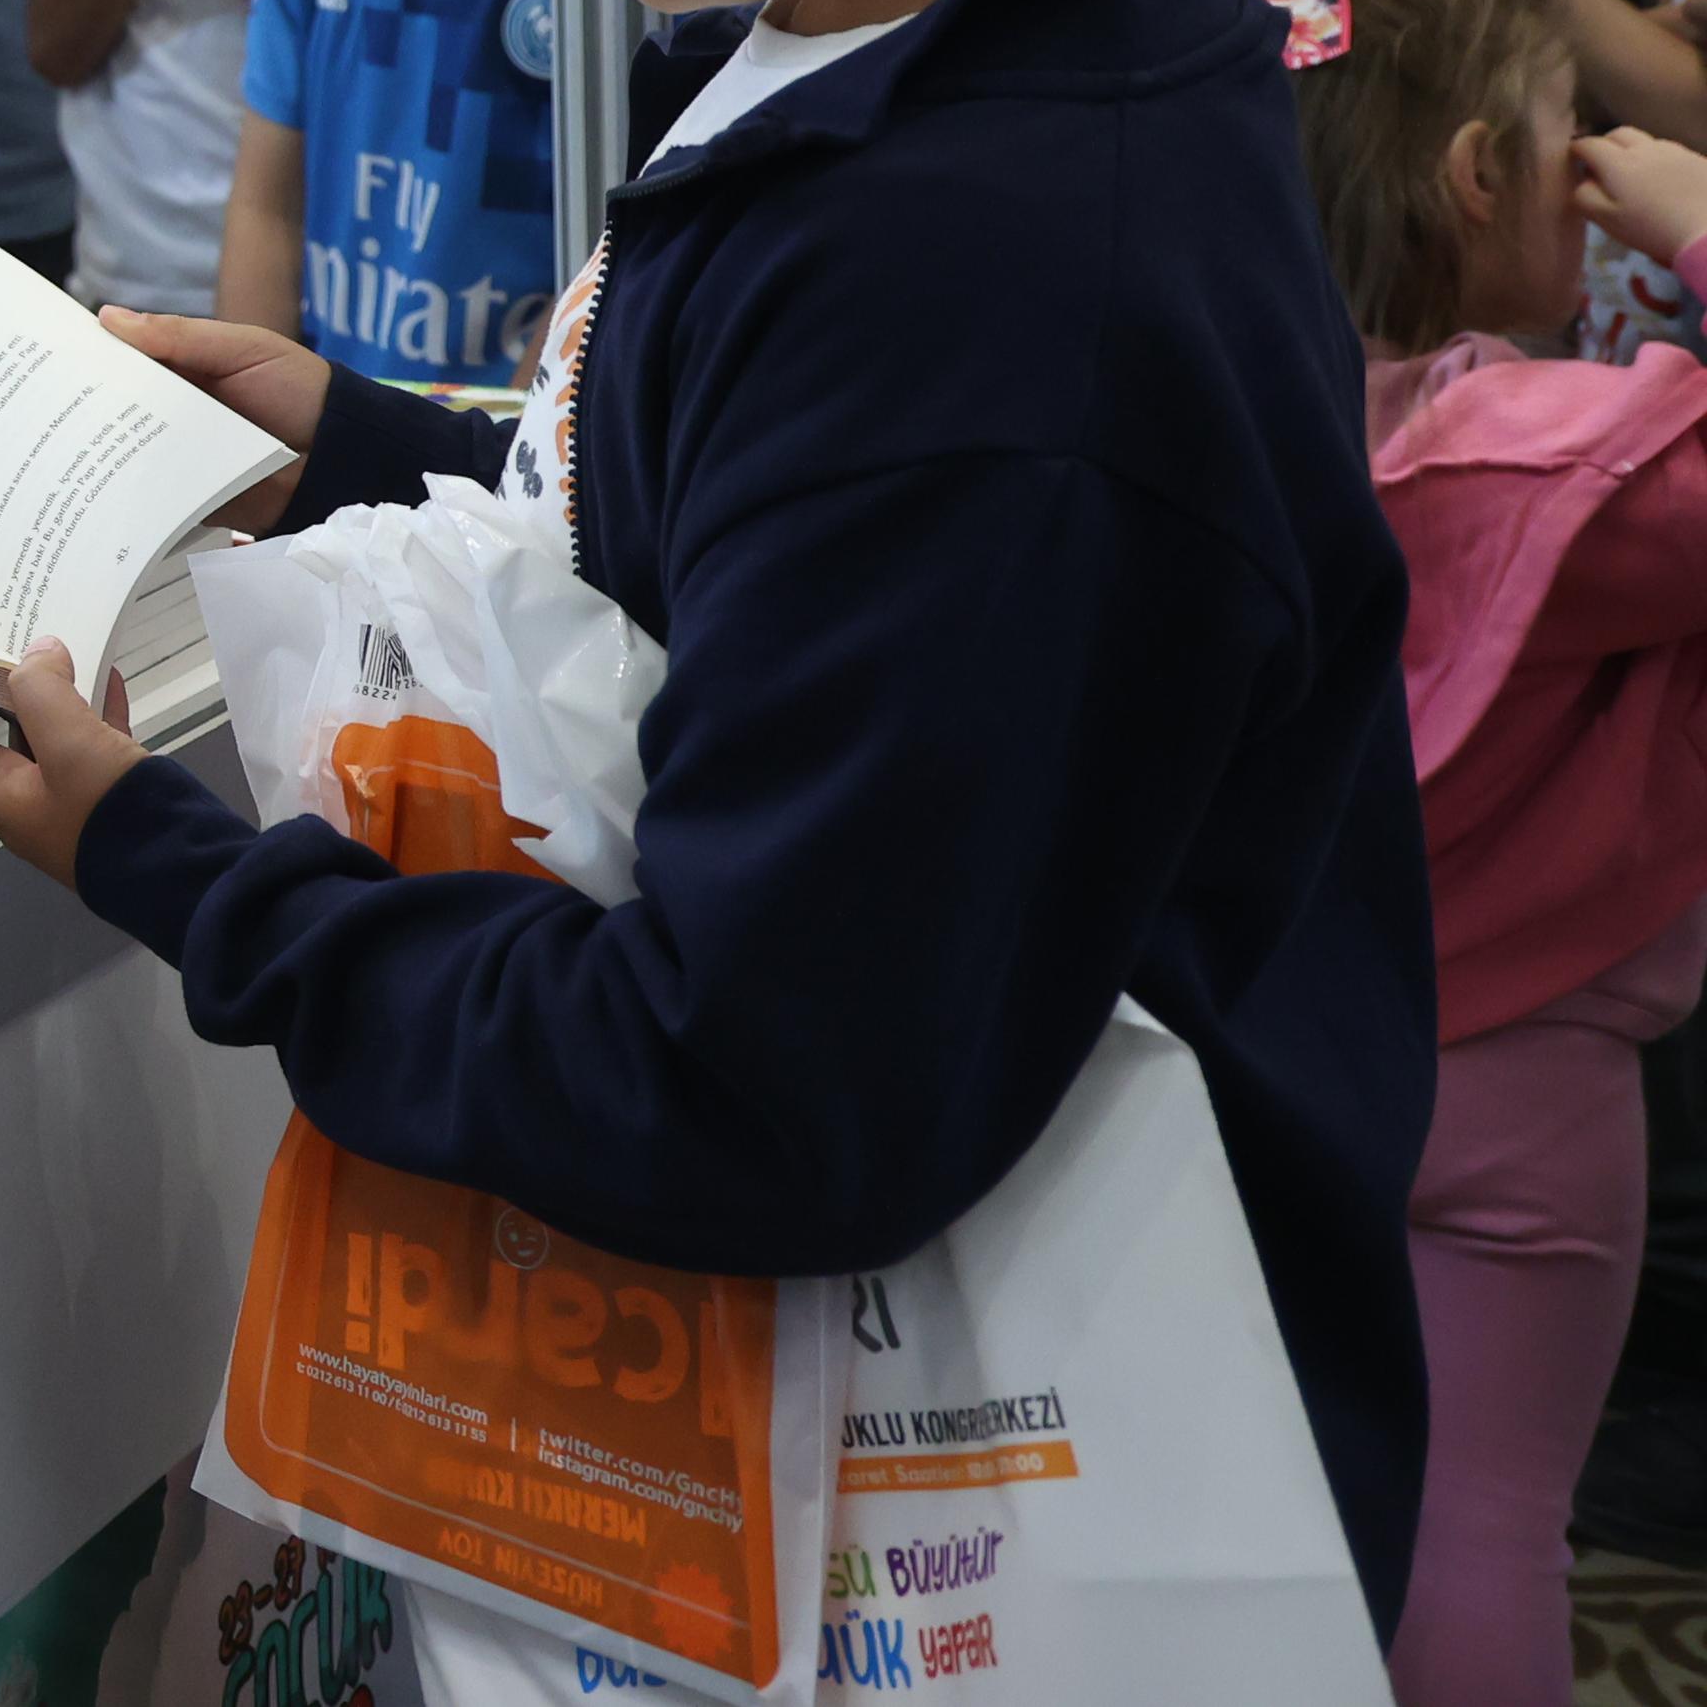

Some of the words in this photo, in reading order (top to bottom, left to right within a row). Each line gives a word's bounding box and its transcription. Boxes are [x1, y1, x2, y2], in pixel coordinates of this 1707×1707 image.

[354, 151, 441, 254] Fly
[27, 430, 54, 460] sende
[48, 393, 85, 432] Mehmet
